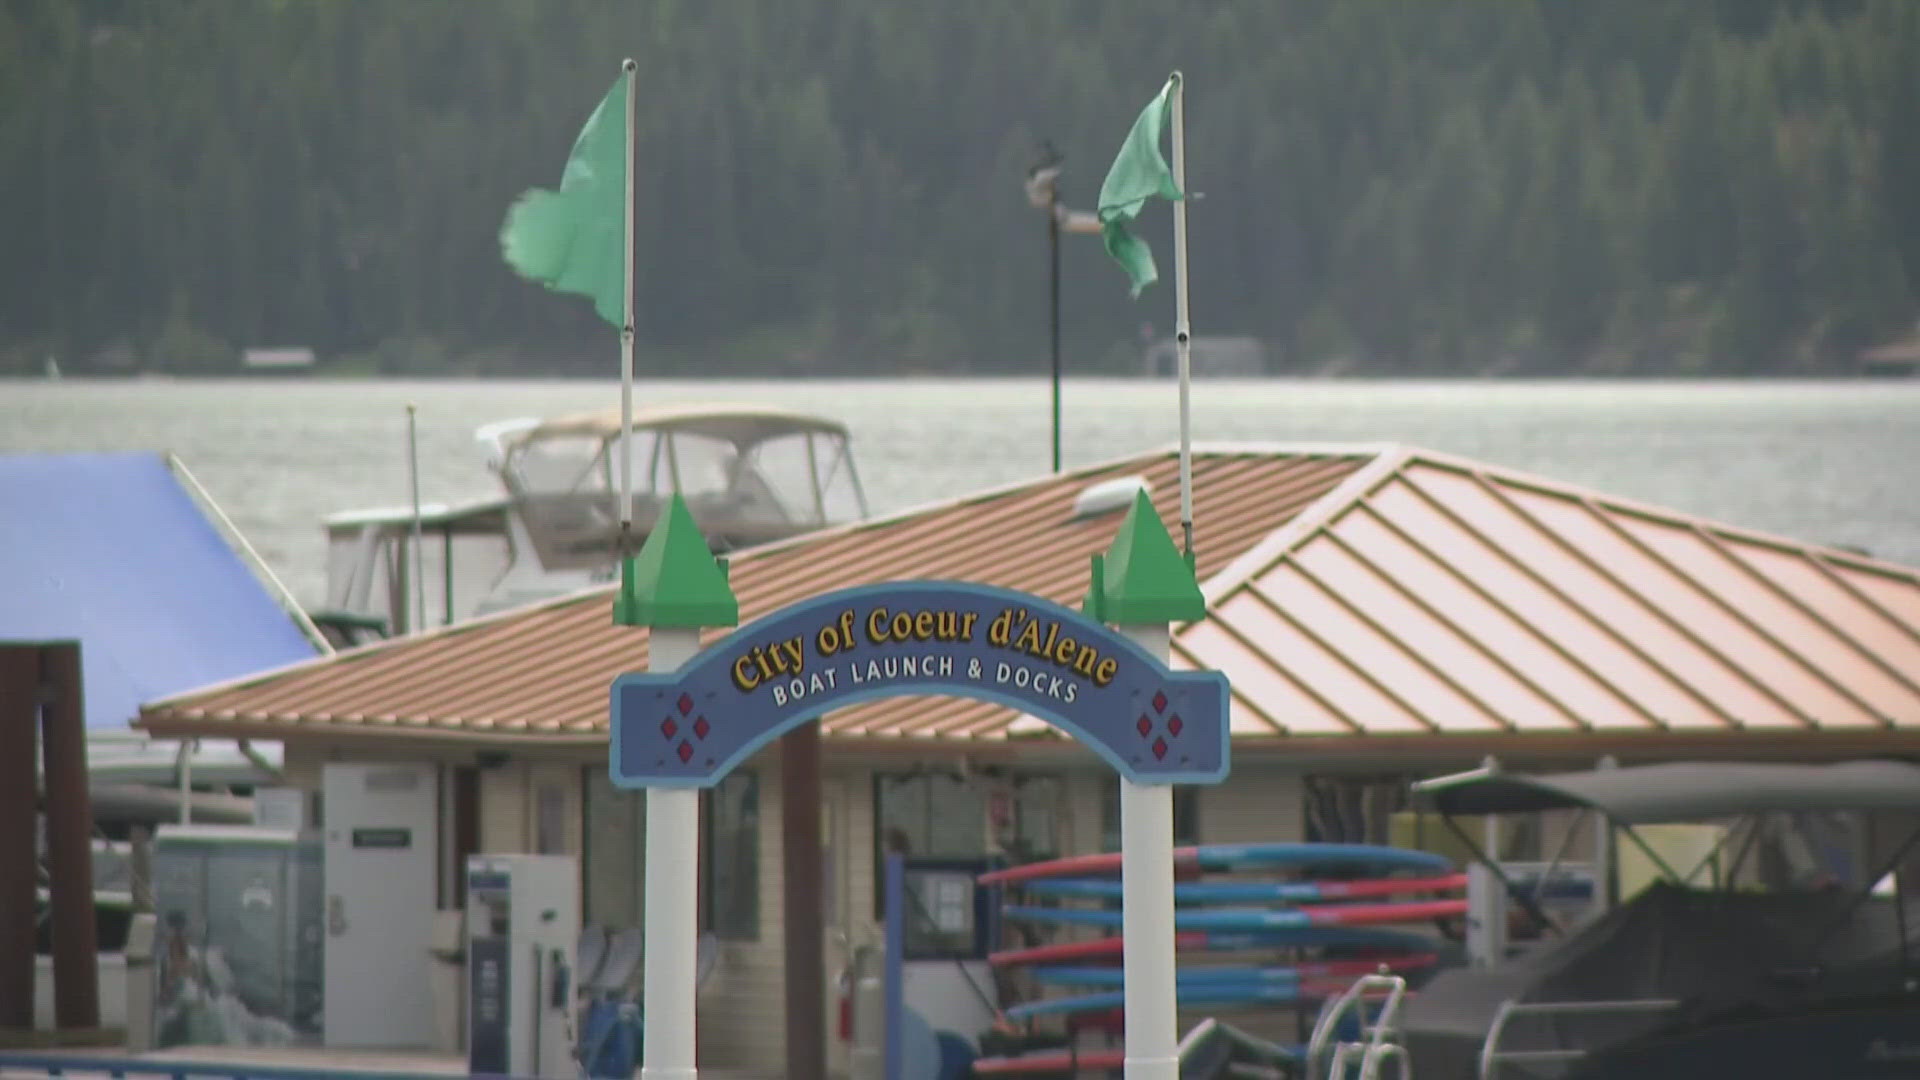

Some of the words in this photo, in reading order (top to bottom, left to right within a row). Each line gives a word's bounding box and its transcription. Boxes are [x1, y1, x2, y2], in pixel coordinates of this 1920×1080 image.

[731, 629, 805, 691] City
[815, 611, 856, 654] of
[865, 607, 977, 644] Coeur
[990, 609, 1119, 686] d'Alene
[772, 667, 838, 707] BOAT
[850, 656, 954, 683] LAUNCH
[968, 658, 982, 679] &
[996, 663, 1080, 704] DOCKS
